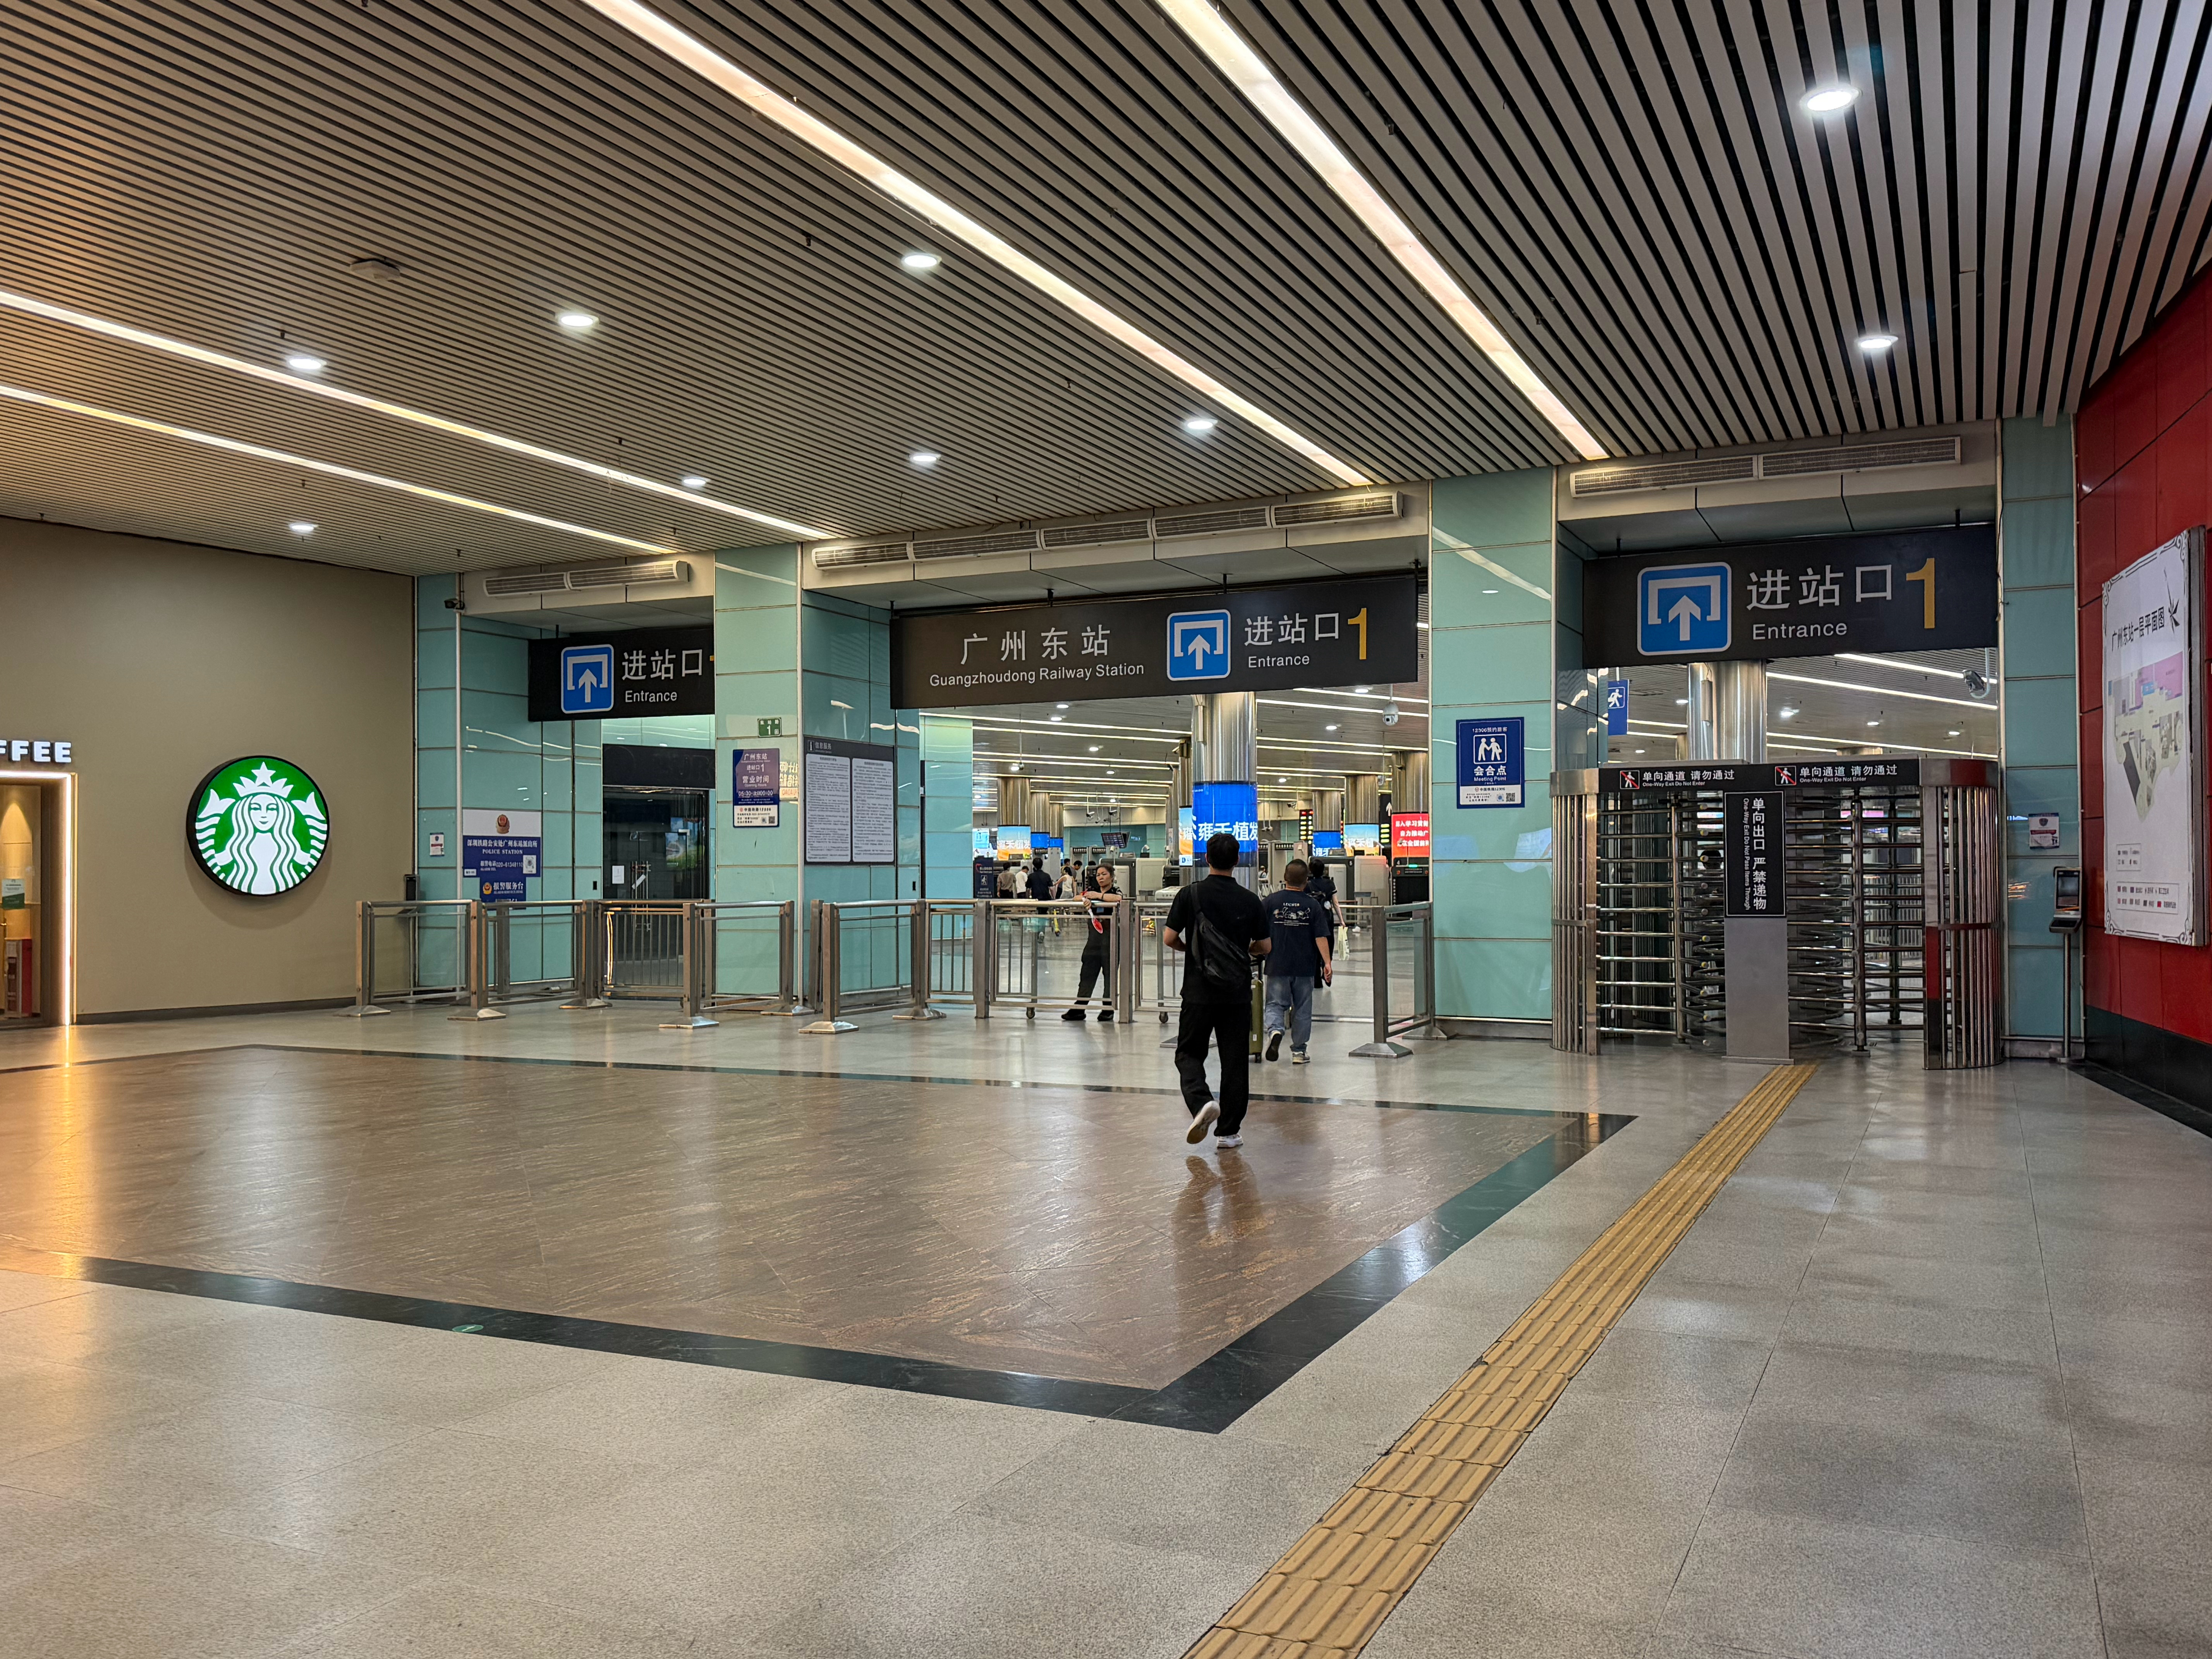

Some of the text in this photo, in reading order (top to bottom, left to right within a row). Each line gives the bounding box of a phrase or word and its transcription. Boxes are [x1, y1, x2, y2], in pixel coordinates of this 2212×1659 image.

[1746, 557, 1935, 629] 进站口 1
[1244, 607, 1367, 660] 进站口 1
[1752, 622, 1847, 640] Entrance
[2112, 606, 2165, 653] 广州东站一层平面图
[961, 624, 1111, 665] 广州东站
[622, 649, 702, 680] 进站口
[1248, 655, 1310, 668] Entrance
[929, 663, 1144, 687] Guangzhoudong Railway Station
[625, 690, 678, 702] Entrance
[766, 725, 771, 735] 1
[815, 742, 832, 750] 信息服务
[1474, 765, 1507, 776] 会合点
[1642, 769, 1735, 781] 单向通道 请勿通过
[1800, 764, 1898, 777] 单向通道 请勿通过
[742, 775, 769, 783] 营业时间
[1752, 797, 1767, 910] 单向出口 严禁递物
[493, 882, 524, 890] 报警服务台
